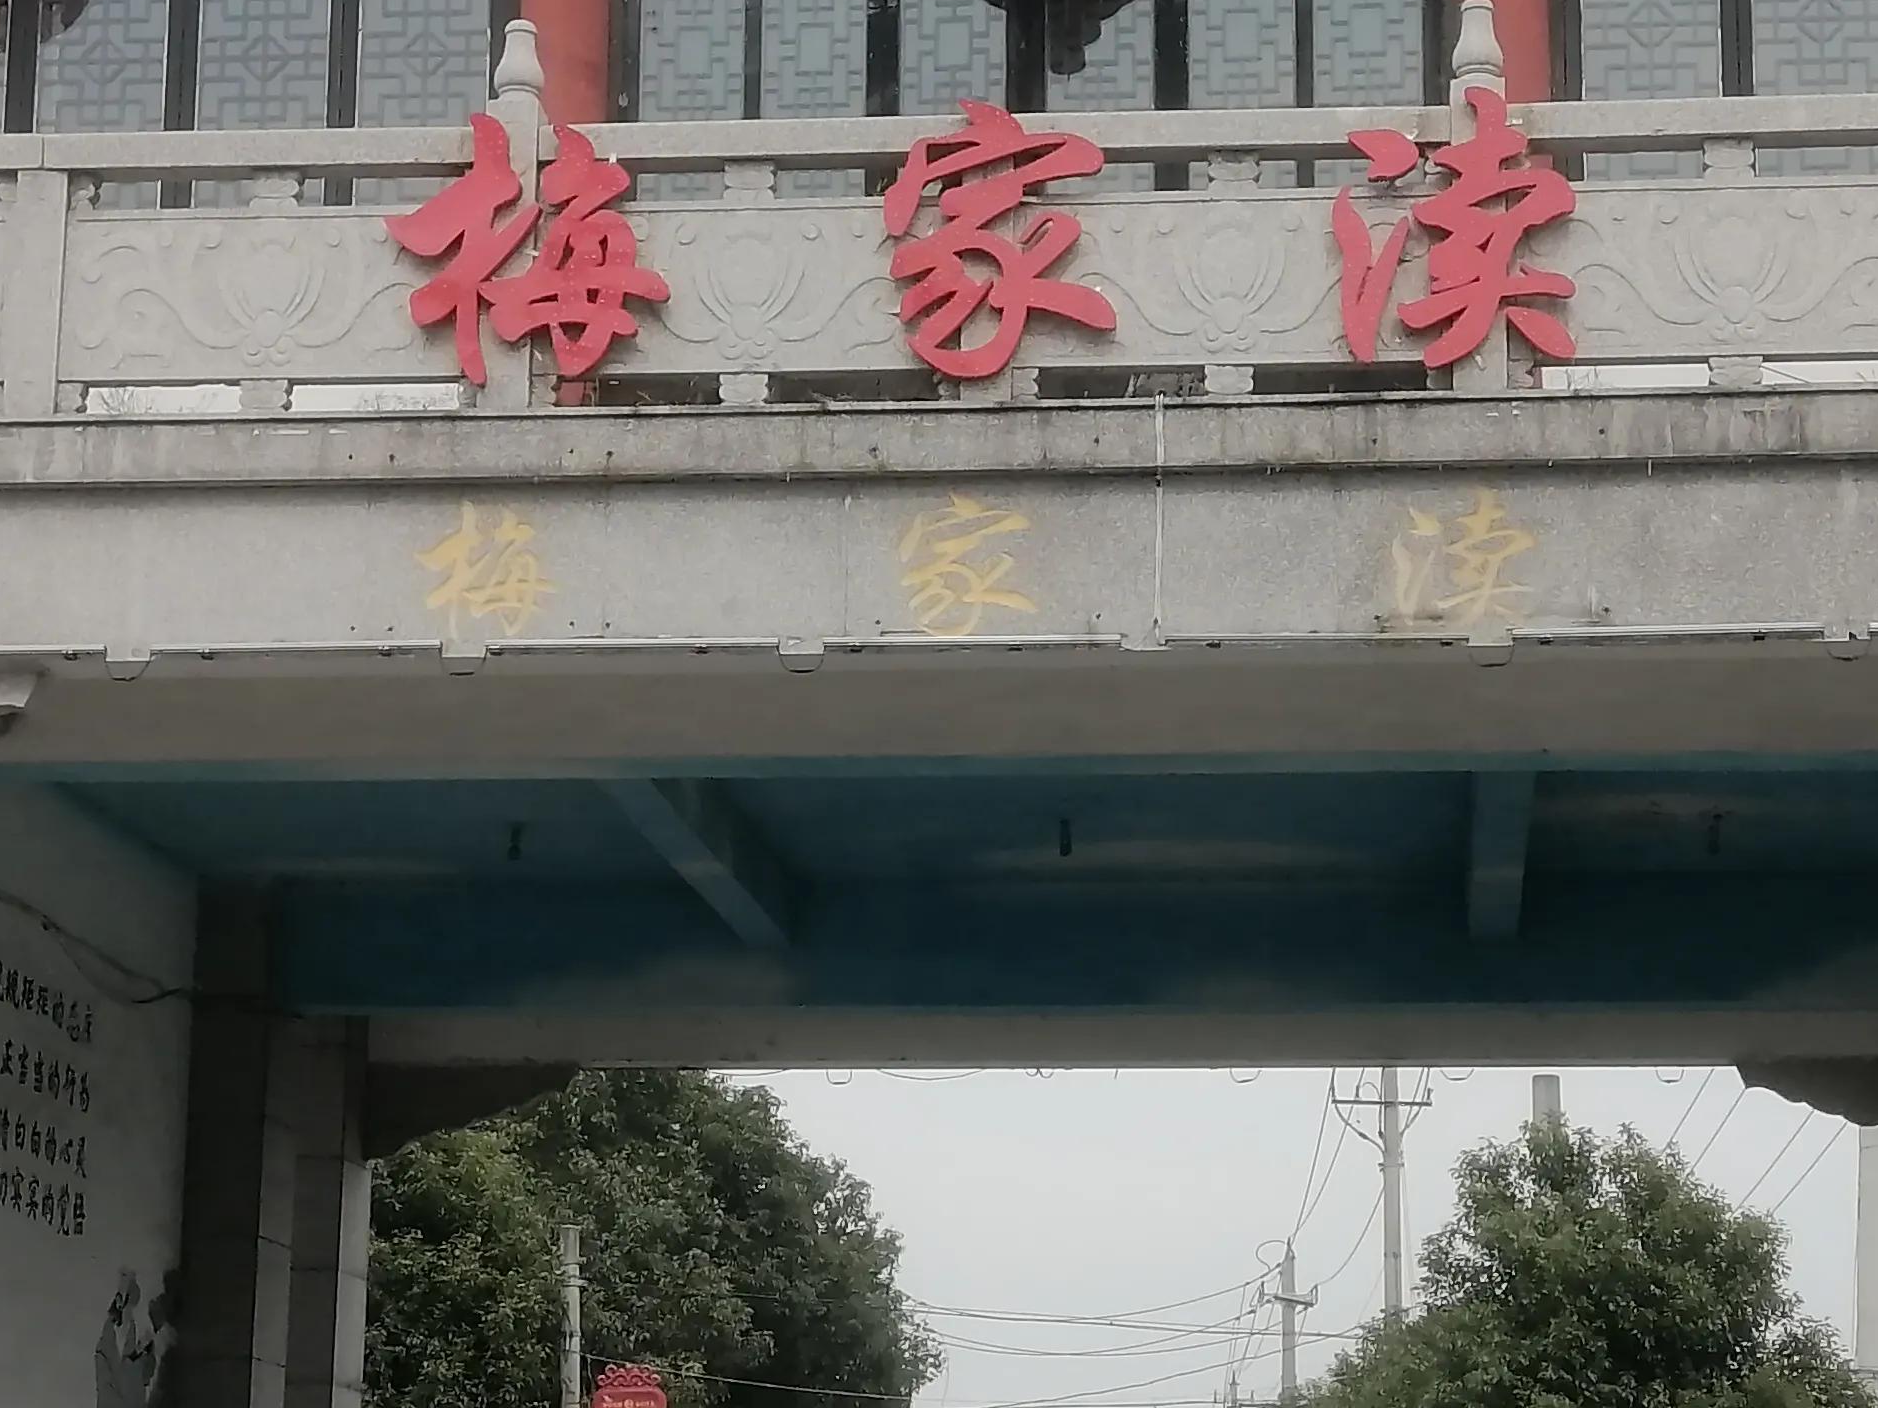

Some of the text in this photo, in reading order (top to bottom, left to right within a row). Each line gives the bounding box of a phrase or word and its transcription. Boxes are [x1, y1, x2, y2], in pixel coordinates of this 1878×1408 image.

[384, 86, 1577, 385] 梅家渎
[414, 487, 1539, 639] 梅家渎
